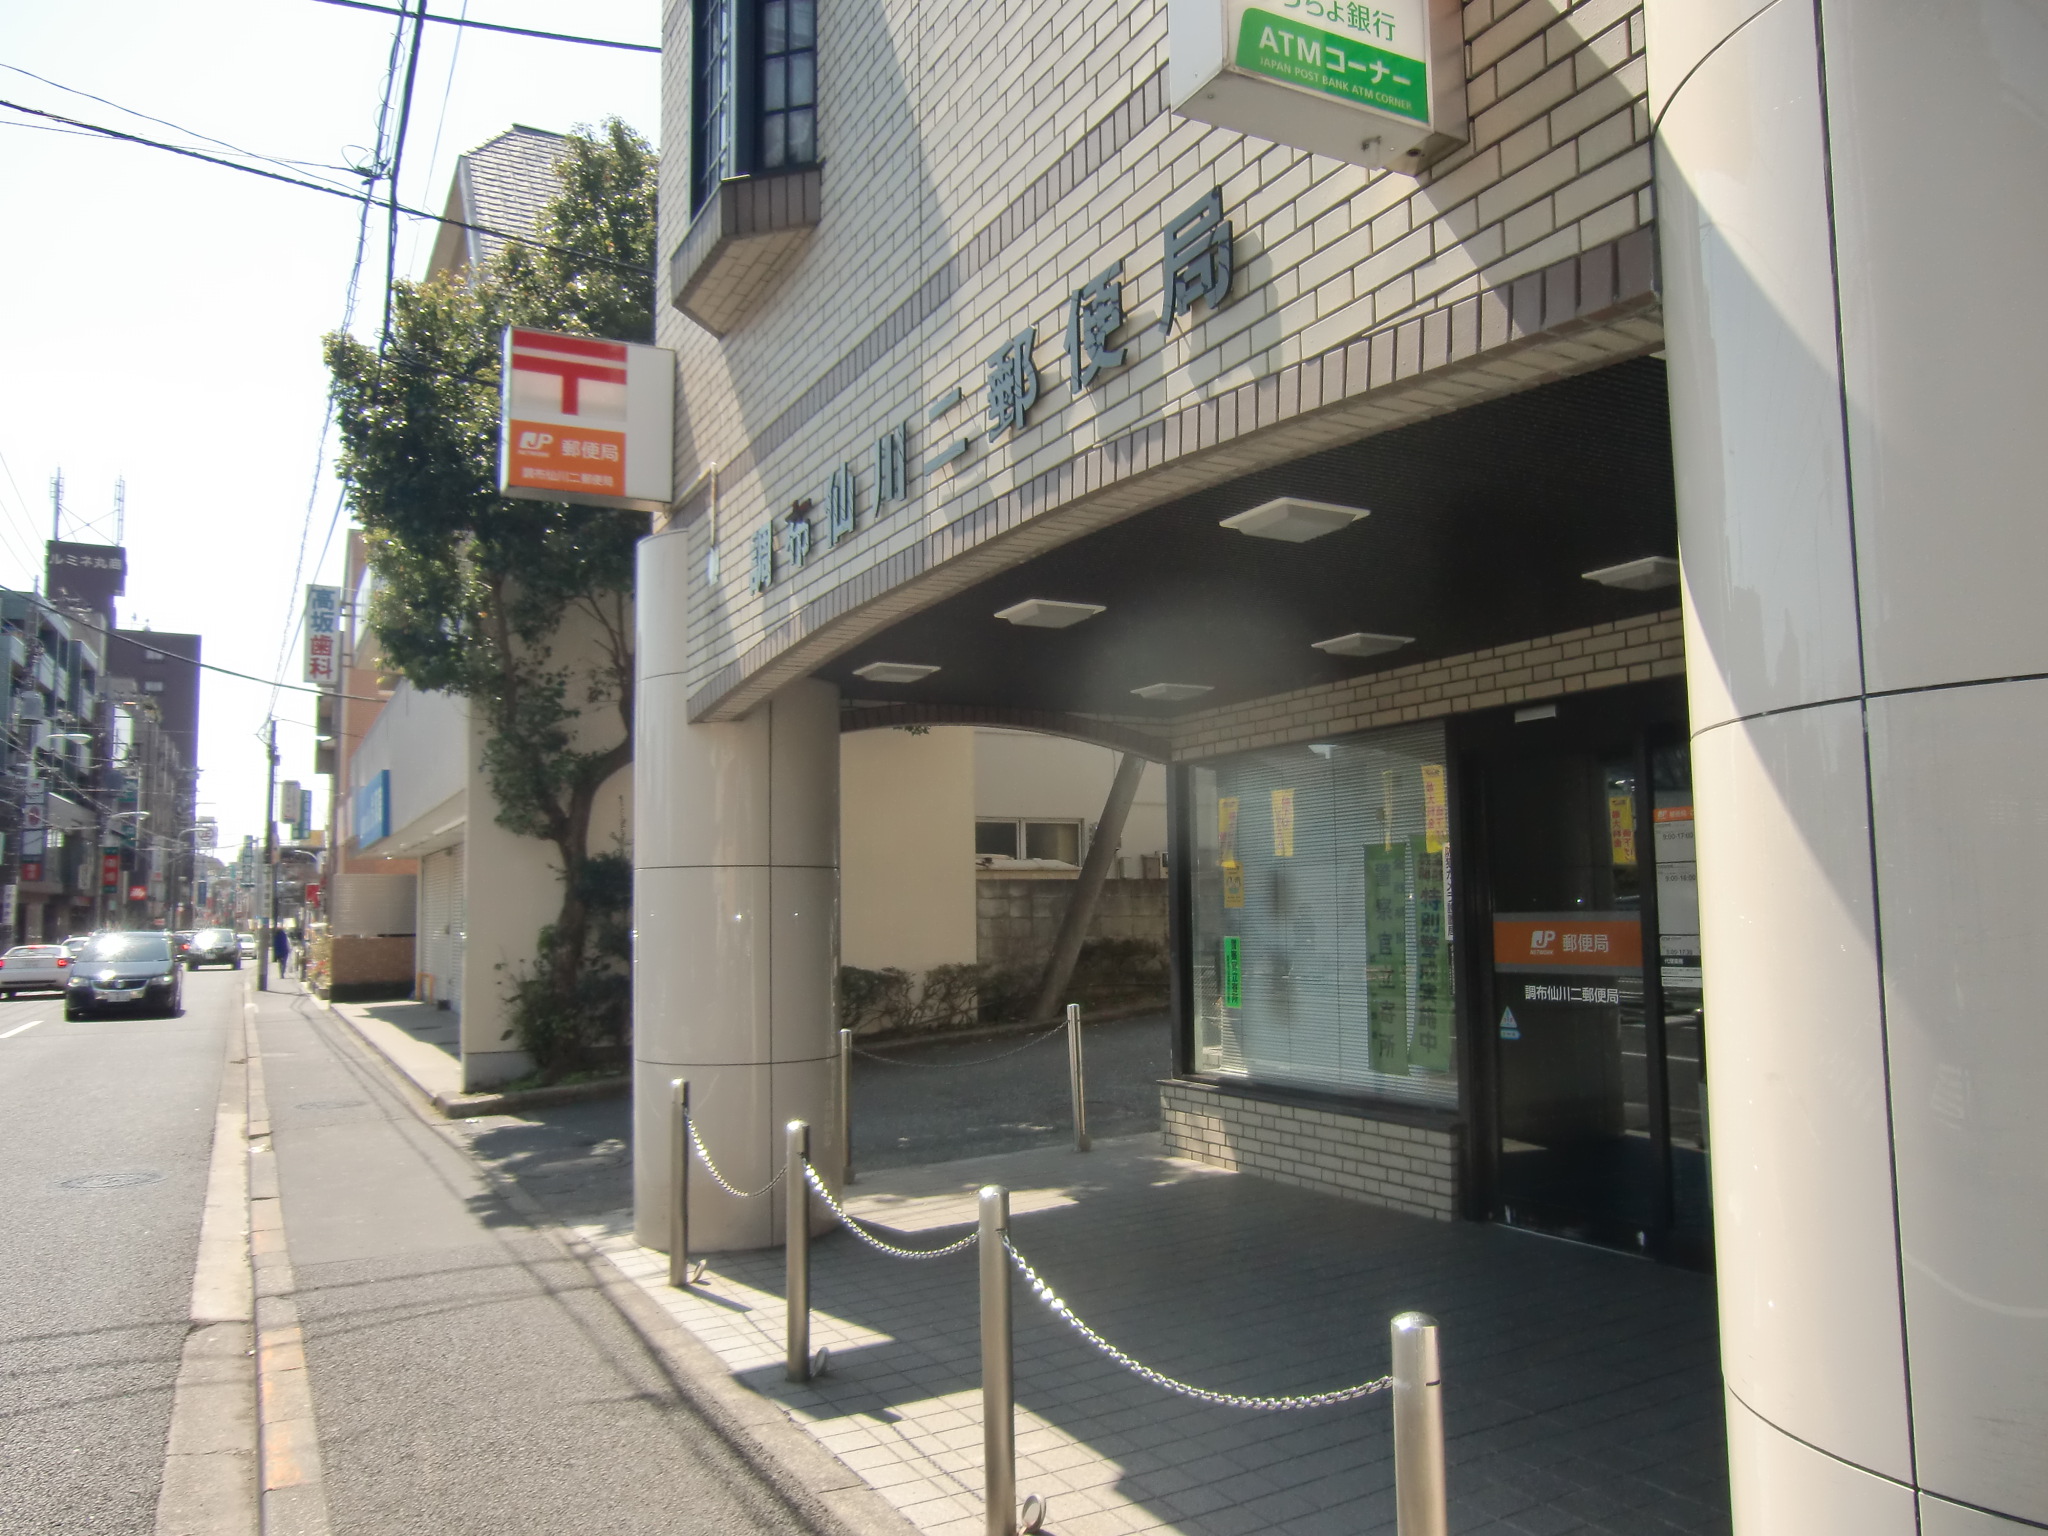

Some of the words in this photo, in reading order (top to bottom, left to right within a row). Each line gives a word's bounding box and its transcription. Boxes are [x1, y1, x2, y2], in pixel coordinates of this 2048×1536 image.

[1258, 26, 1412, 86] ATMコーナー
[1260, 57, 1292, 73] JAPAN
[1295, 67, 1320, 83] POST
[1322, 76, 1350, 92] BANK
[1352, 85, 1374, 99] ATM
[1375, 91, 1412, 111] CORNER
[561, 439, 620, 463] 郵便局
[309, 589, 336, 679] 高坂歯科
[1531, 930, 1556, 949] JP
[1562, 933, 1609, 953] 郵便局
[1525, 985, 1619, 1004] 調布仙川二郵便局
